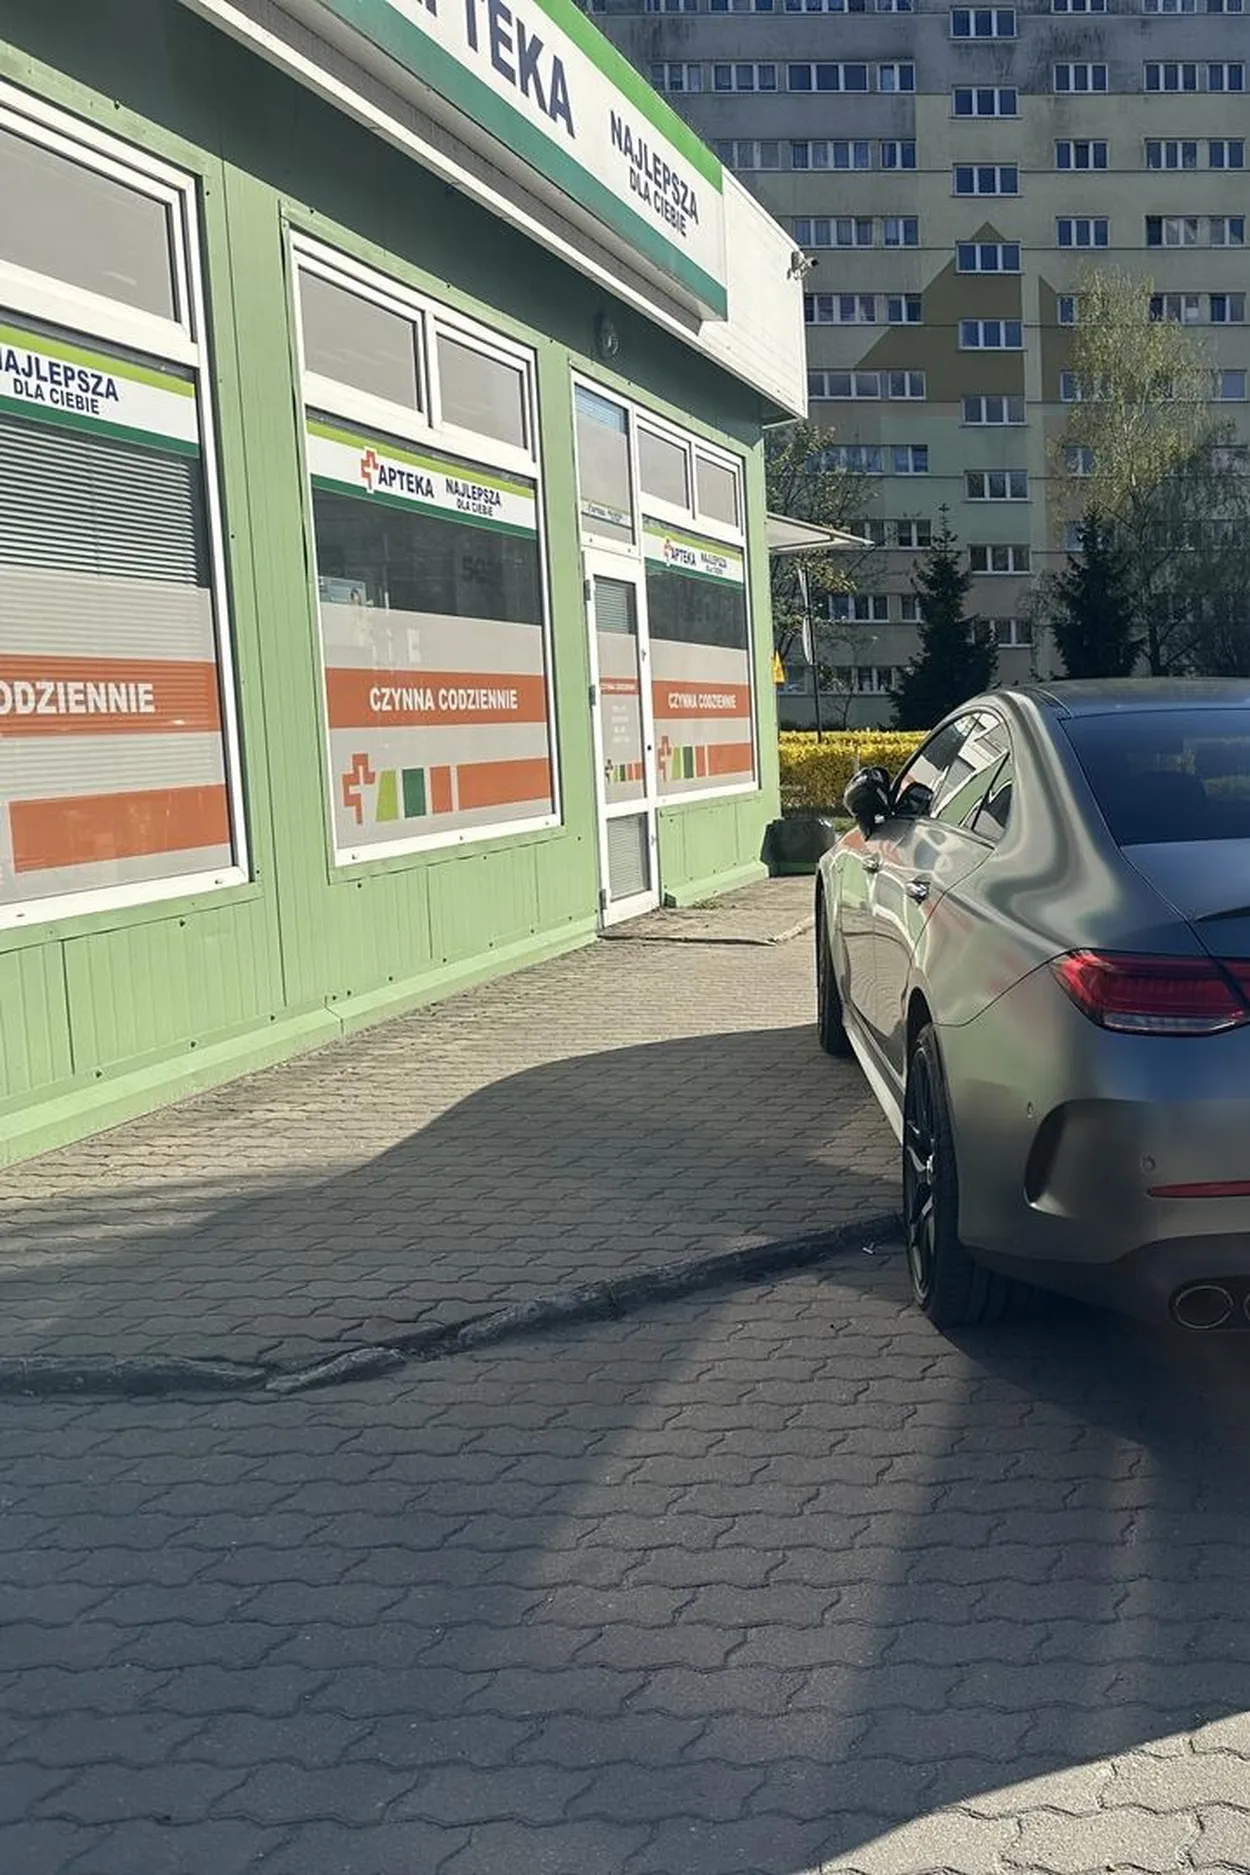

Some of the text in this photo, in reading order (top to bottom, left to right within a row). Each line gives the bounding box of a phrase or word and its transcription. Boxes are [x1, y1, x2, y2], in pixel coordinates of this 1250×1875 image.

[609, 109, 700, 225] NAJLEPSZA
[628, 166, 688, 238] DLA CIEBIE
[0, 347, 120, 402] AJLEPSZA
[13, 377, 100, 415] DLA CIEBIE
[377, 464, 503, 507] APTEKA NAJLEPSZA
[370, 686, 519, 712] CZYNNA CODZIENNIE
